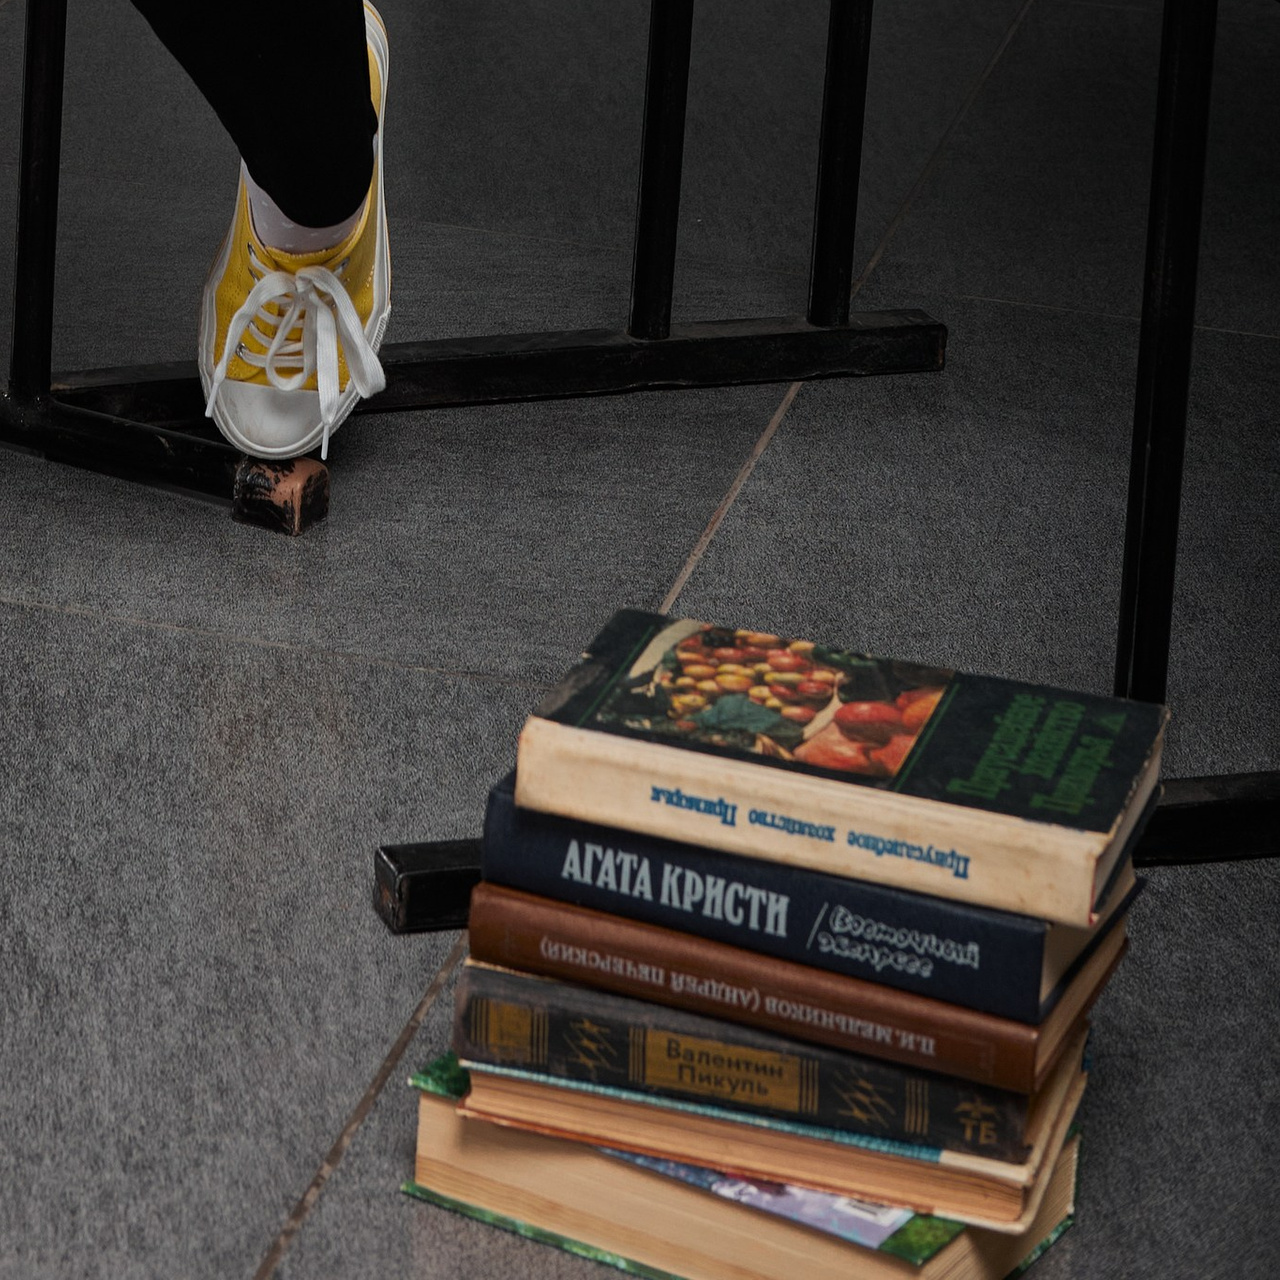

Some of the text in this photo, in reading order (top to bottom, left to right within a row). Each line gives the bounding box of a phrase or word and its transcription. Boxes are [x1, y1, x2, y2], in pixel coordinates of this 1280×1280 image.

[650, 785, 971, 880] Приусадебное хозяйство Приморья
[561, 838, 791, 939] АГАТА КРИСТИ
[665, 1038, 785, 1081] Валентин
[676, 1063, 770, 1098] Пикуль
